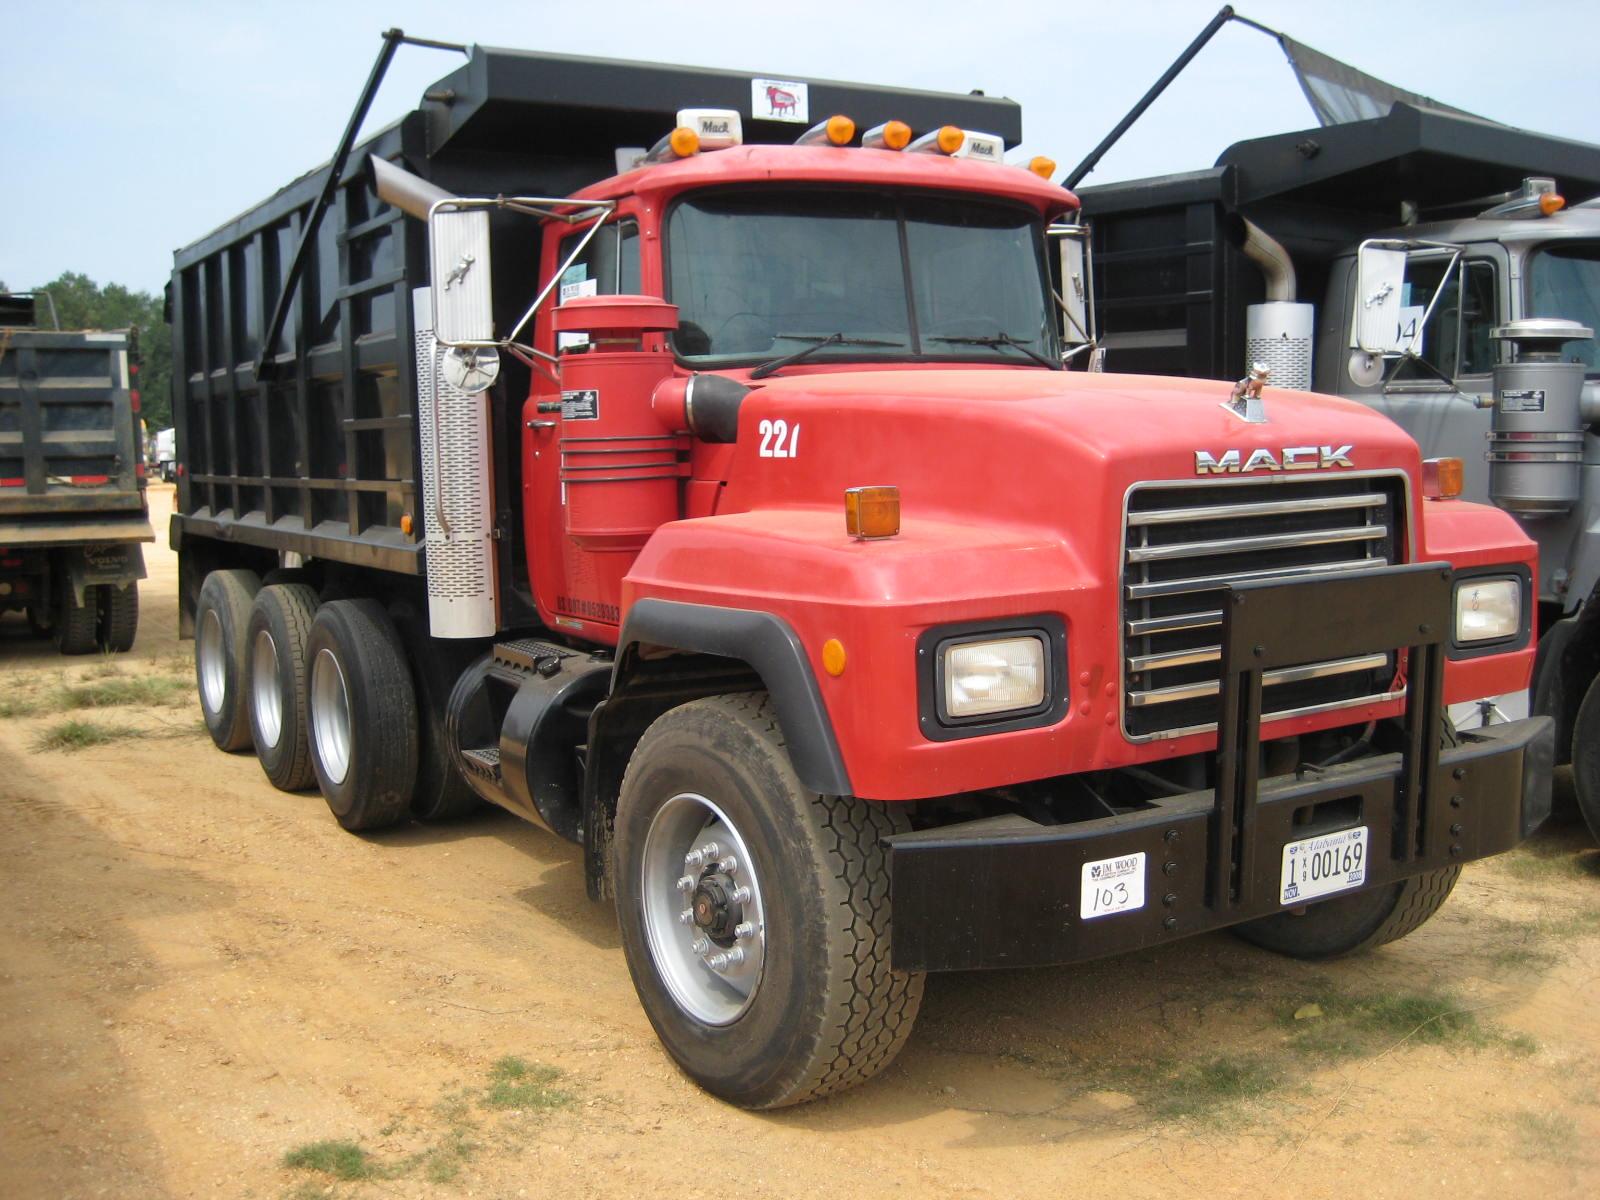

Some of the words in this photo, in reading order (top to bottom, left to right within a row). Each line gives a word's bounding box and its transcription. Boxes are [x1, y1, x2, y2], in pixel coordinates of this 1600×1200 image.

[702, 121, 729, 134] Mack
[971, 142, 994, 156] Mack
[759, 419, 800, 458] 221
[1195, 445, 1354, 475] MACK
[1115, 858, 1138, 870] WOOD
[1311, 842, 1363, 881] 00169
[1093, 882, 1129, 911] 103
